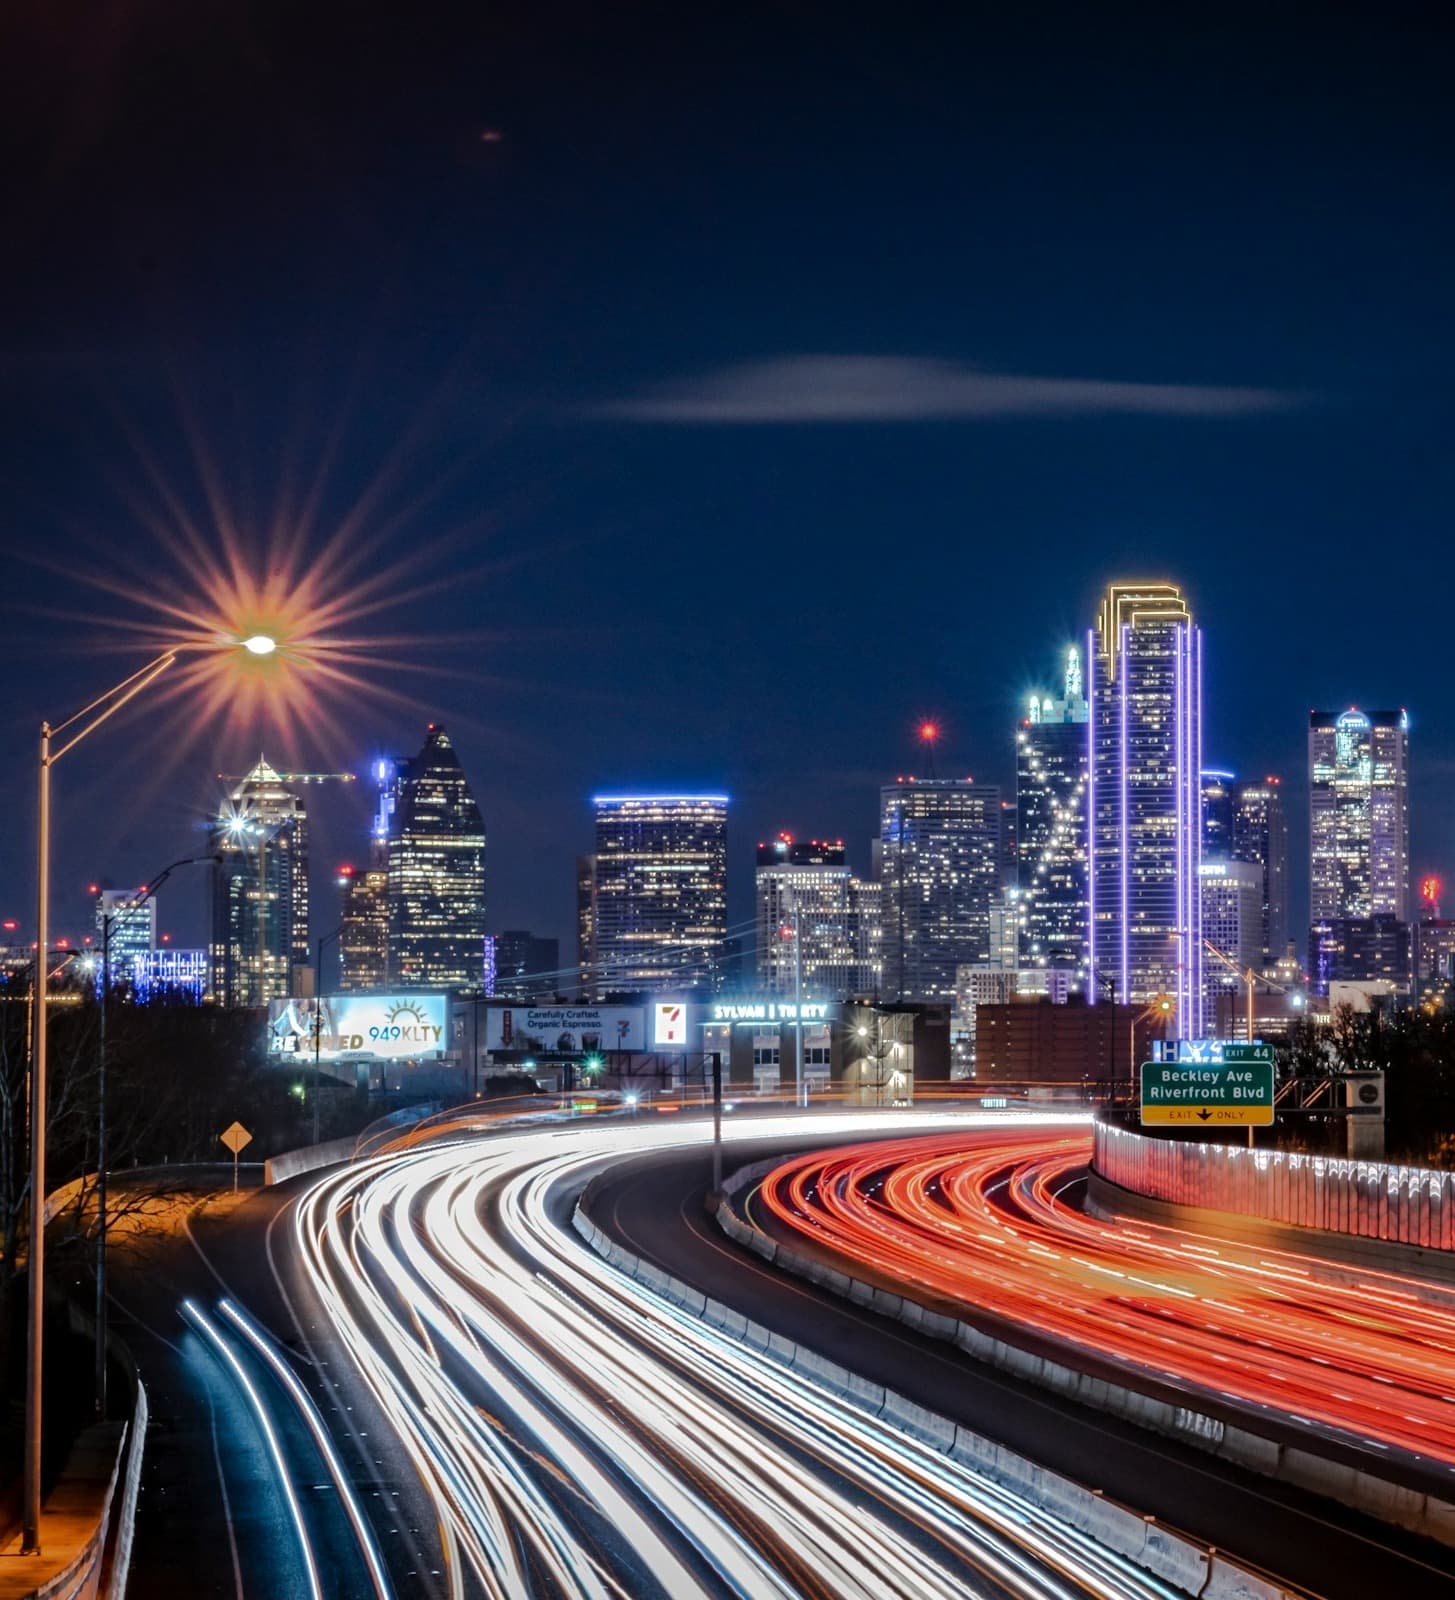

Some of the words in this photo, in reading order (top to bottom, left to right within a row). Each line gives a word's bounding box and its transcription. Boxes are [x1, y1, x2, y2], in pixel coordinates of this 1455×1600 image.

[527, 1010, 564, 1020] Carefully
[566, 1010, 601, 1019] Crafted.
[714, 1005, 765, 1019] SYLVAN
[778, 1004, 828, 1018] THRTY
[527, 1020, 561, 1030] Organic
[1225, 1049, 1244, 1057] EXIT
[1253, 1047, 1269, 1058] 44
[1161, 1070, 1220, 1085] Beckley
[1226, 1070, 1253, 1082] Ave
[1150, 1086, 1225, 1099] Riverfront
[1233, 1086, 1264, 1099] Blvd
[1169, 1111, 1192, 1119] EXIT
[1217, 1111, 1245, 1119] ONLY
